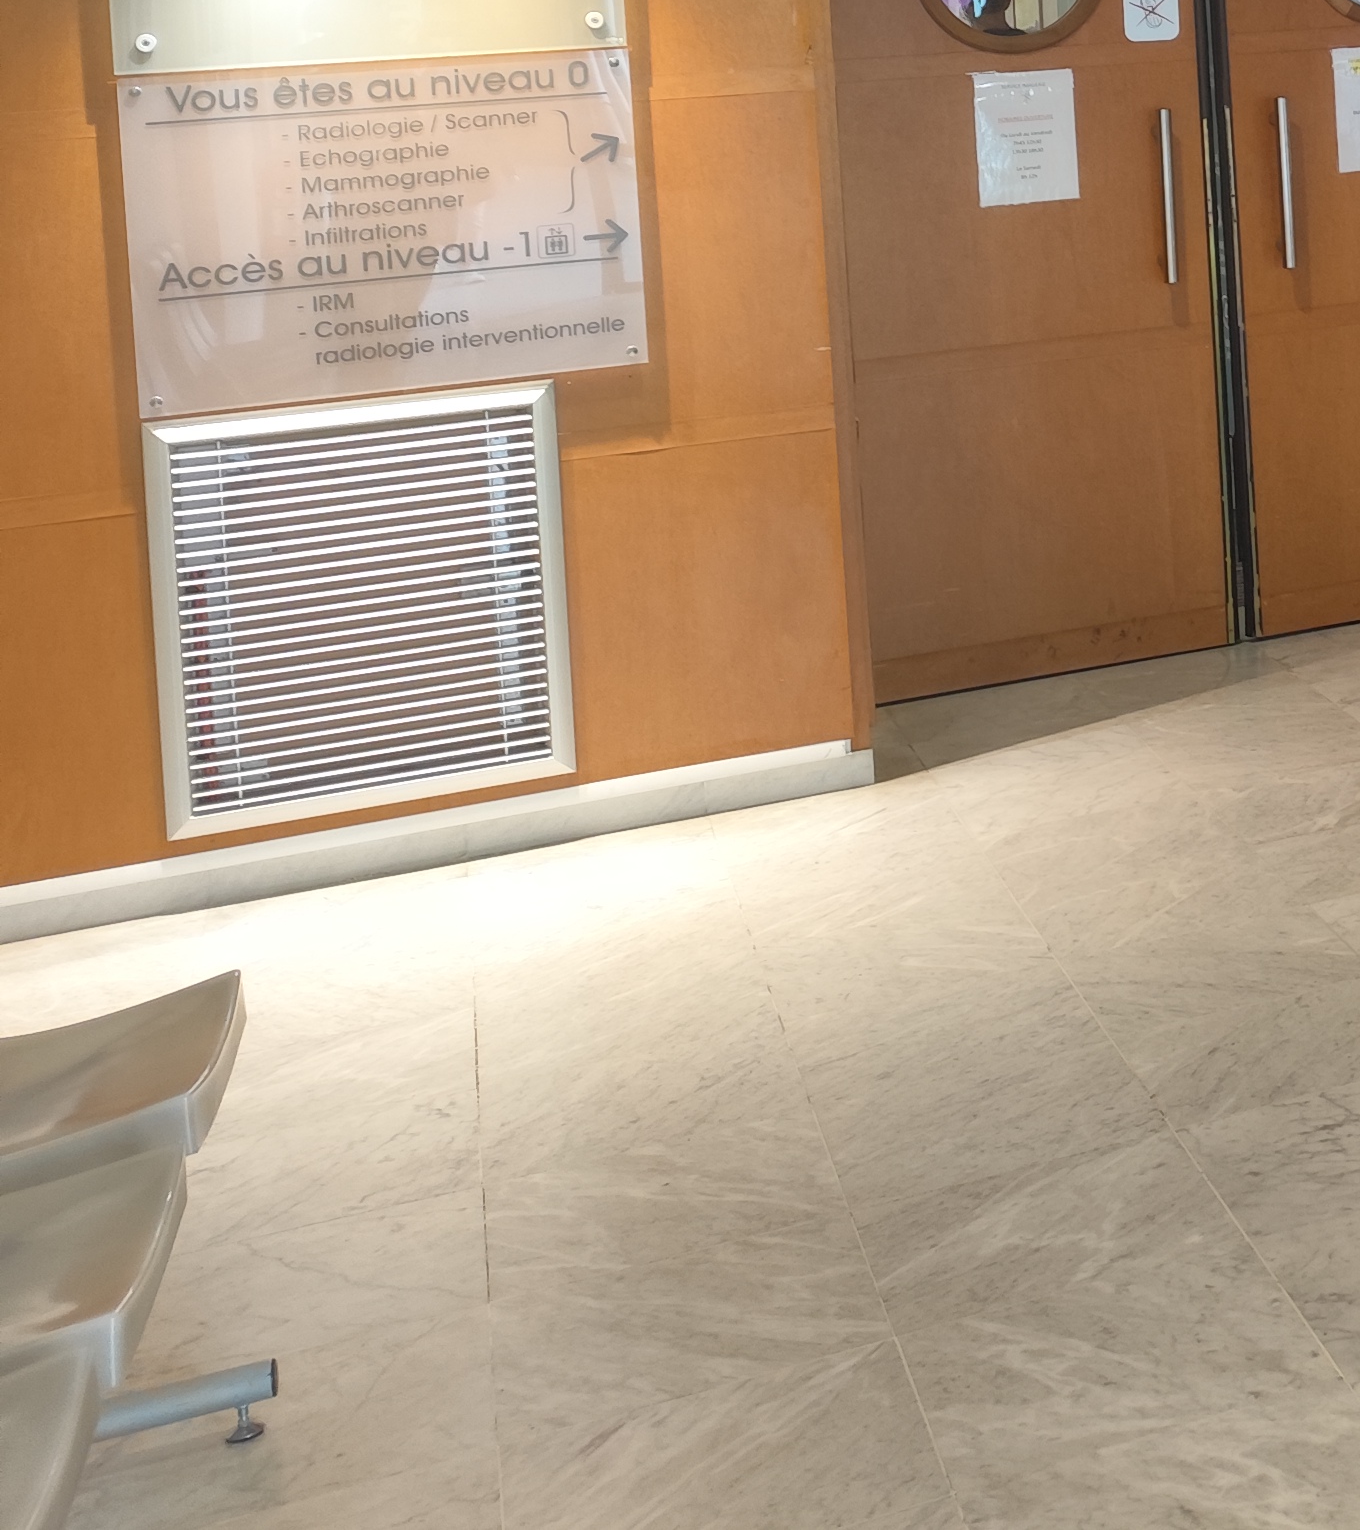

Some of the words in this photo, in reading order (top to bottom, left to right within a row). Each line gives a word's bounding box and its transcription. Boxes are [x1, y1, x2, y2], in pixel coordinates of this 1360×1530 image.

[165, 83, 258, 115] Vous
[273, 76, 352, 109] êtes
[367, 74, 415, 101] au
[430, 66, 555, 98] niveau
[568, 61, 589, 89] 0
[297, 116, 423, 146] Radiologie
[429, 114, 438, 134] /
[445, 109, 538, 131] Scanner
[300, 141, 449, 171] Echographie
[301, 164, 490, 195] Mammographie
[302, 192, 464, 222] Arthroscanner
[304, 220, 427, 246] Infiltrations
[159, 253, 283, 293] Accès
[297, 252, 348, 281] au
[362, 240, 490, 273] niveau
[503, 230, 533, 258] -1
[312, 292, 355, 314] IRM
[314, 307, 469, 339] Consultations
[315, 336, 434, 365] radiologie
[442, 315, 625, 353] interventionnelle
